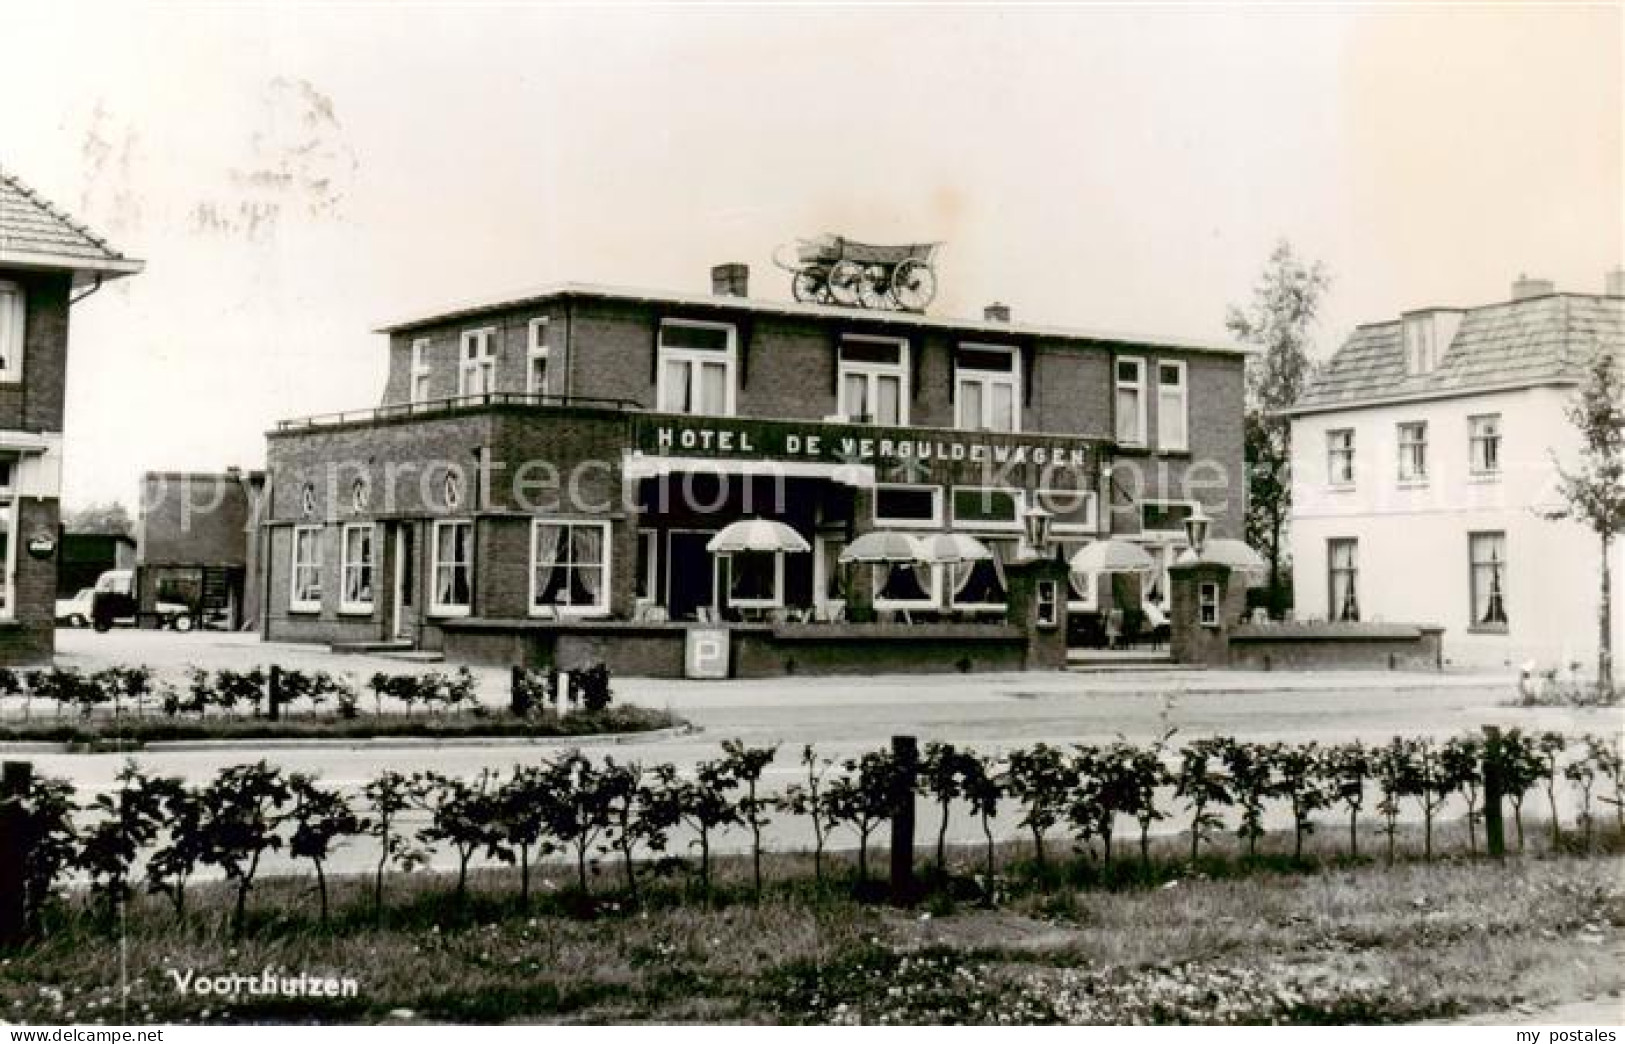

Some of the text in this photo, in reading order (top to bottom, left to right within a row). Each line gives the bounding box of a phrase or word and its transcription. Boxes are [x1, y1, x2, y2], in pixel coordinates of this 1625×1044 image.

[658, 426, 754, 451] HOTEL
[786, 433, 821, 454] DE
[694, 640, 719, 670] P
